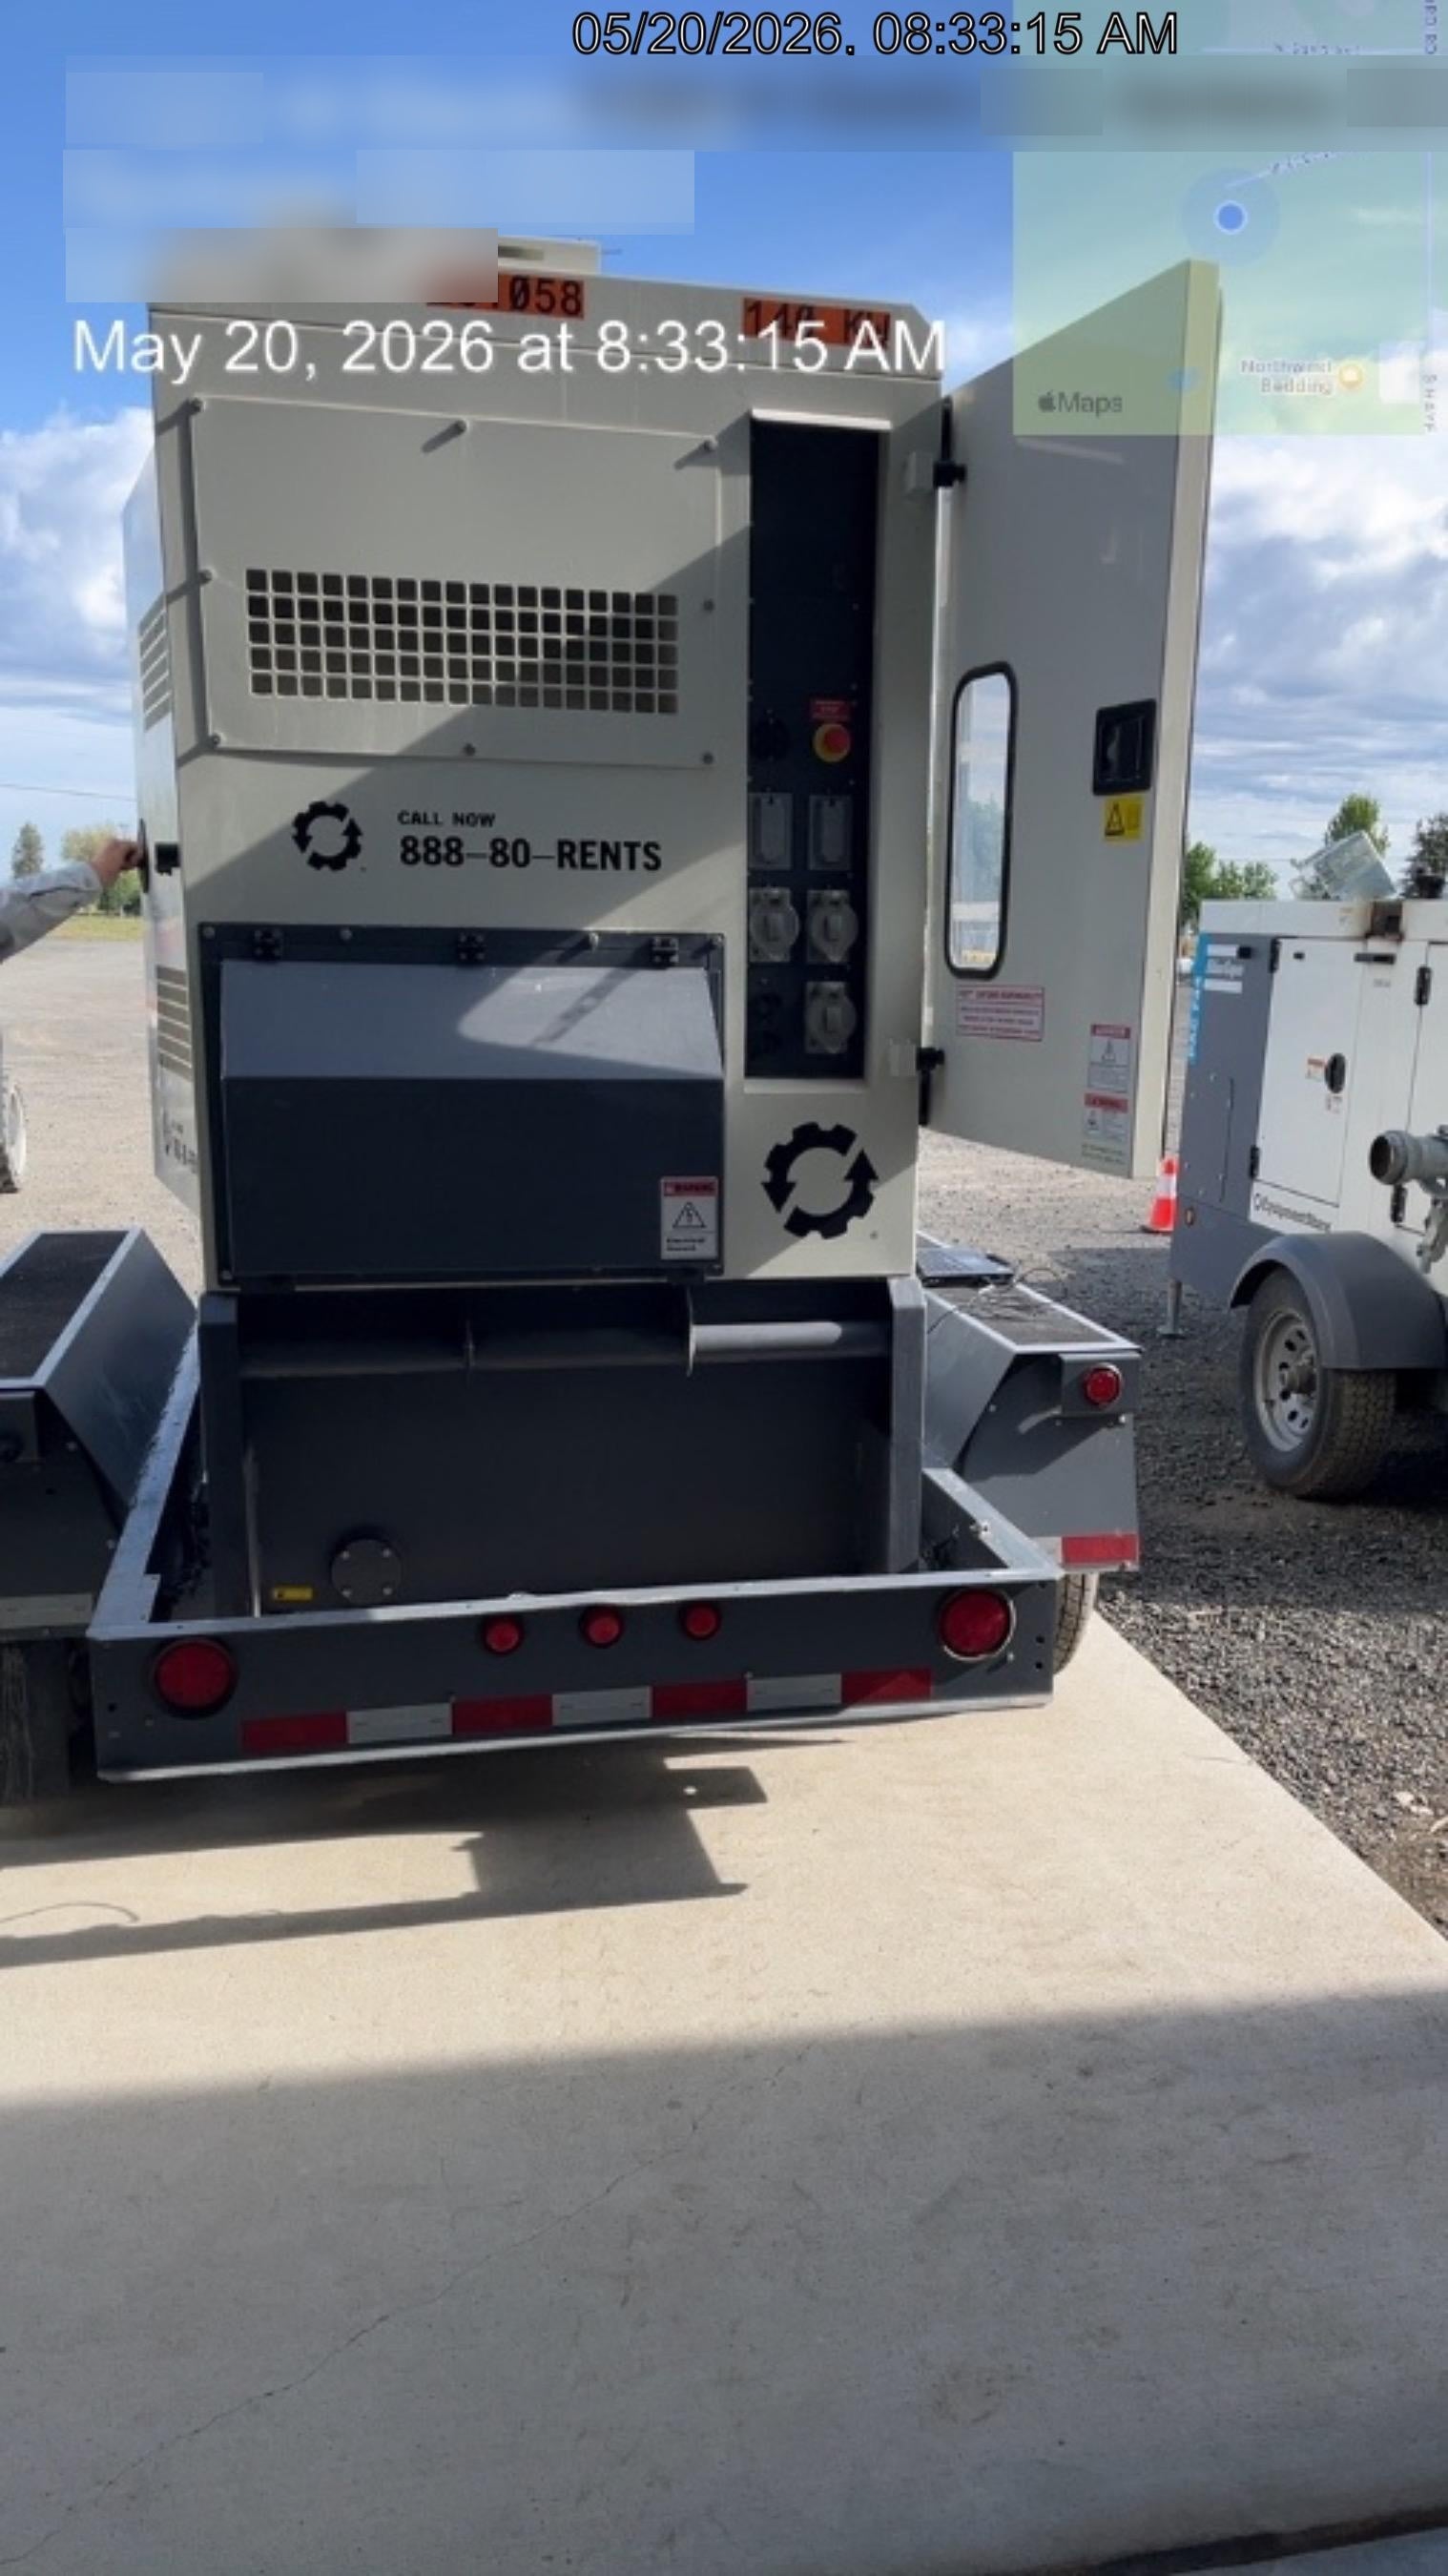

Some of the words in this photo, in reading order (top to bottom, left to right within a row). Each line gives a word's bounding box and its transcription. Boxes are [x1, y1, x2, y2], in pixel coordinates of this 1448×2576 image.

[397, 809, 444, 826] CALL
[452, 811, 495, 827] NOW
[399, 835, 662, 871] 888-80-RENTS
